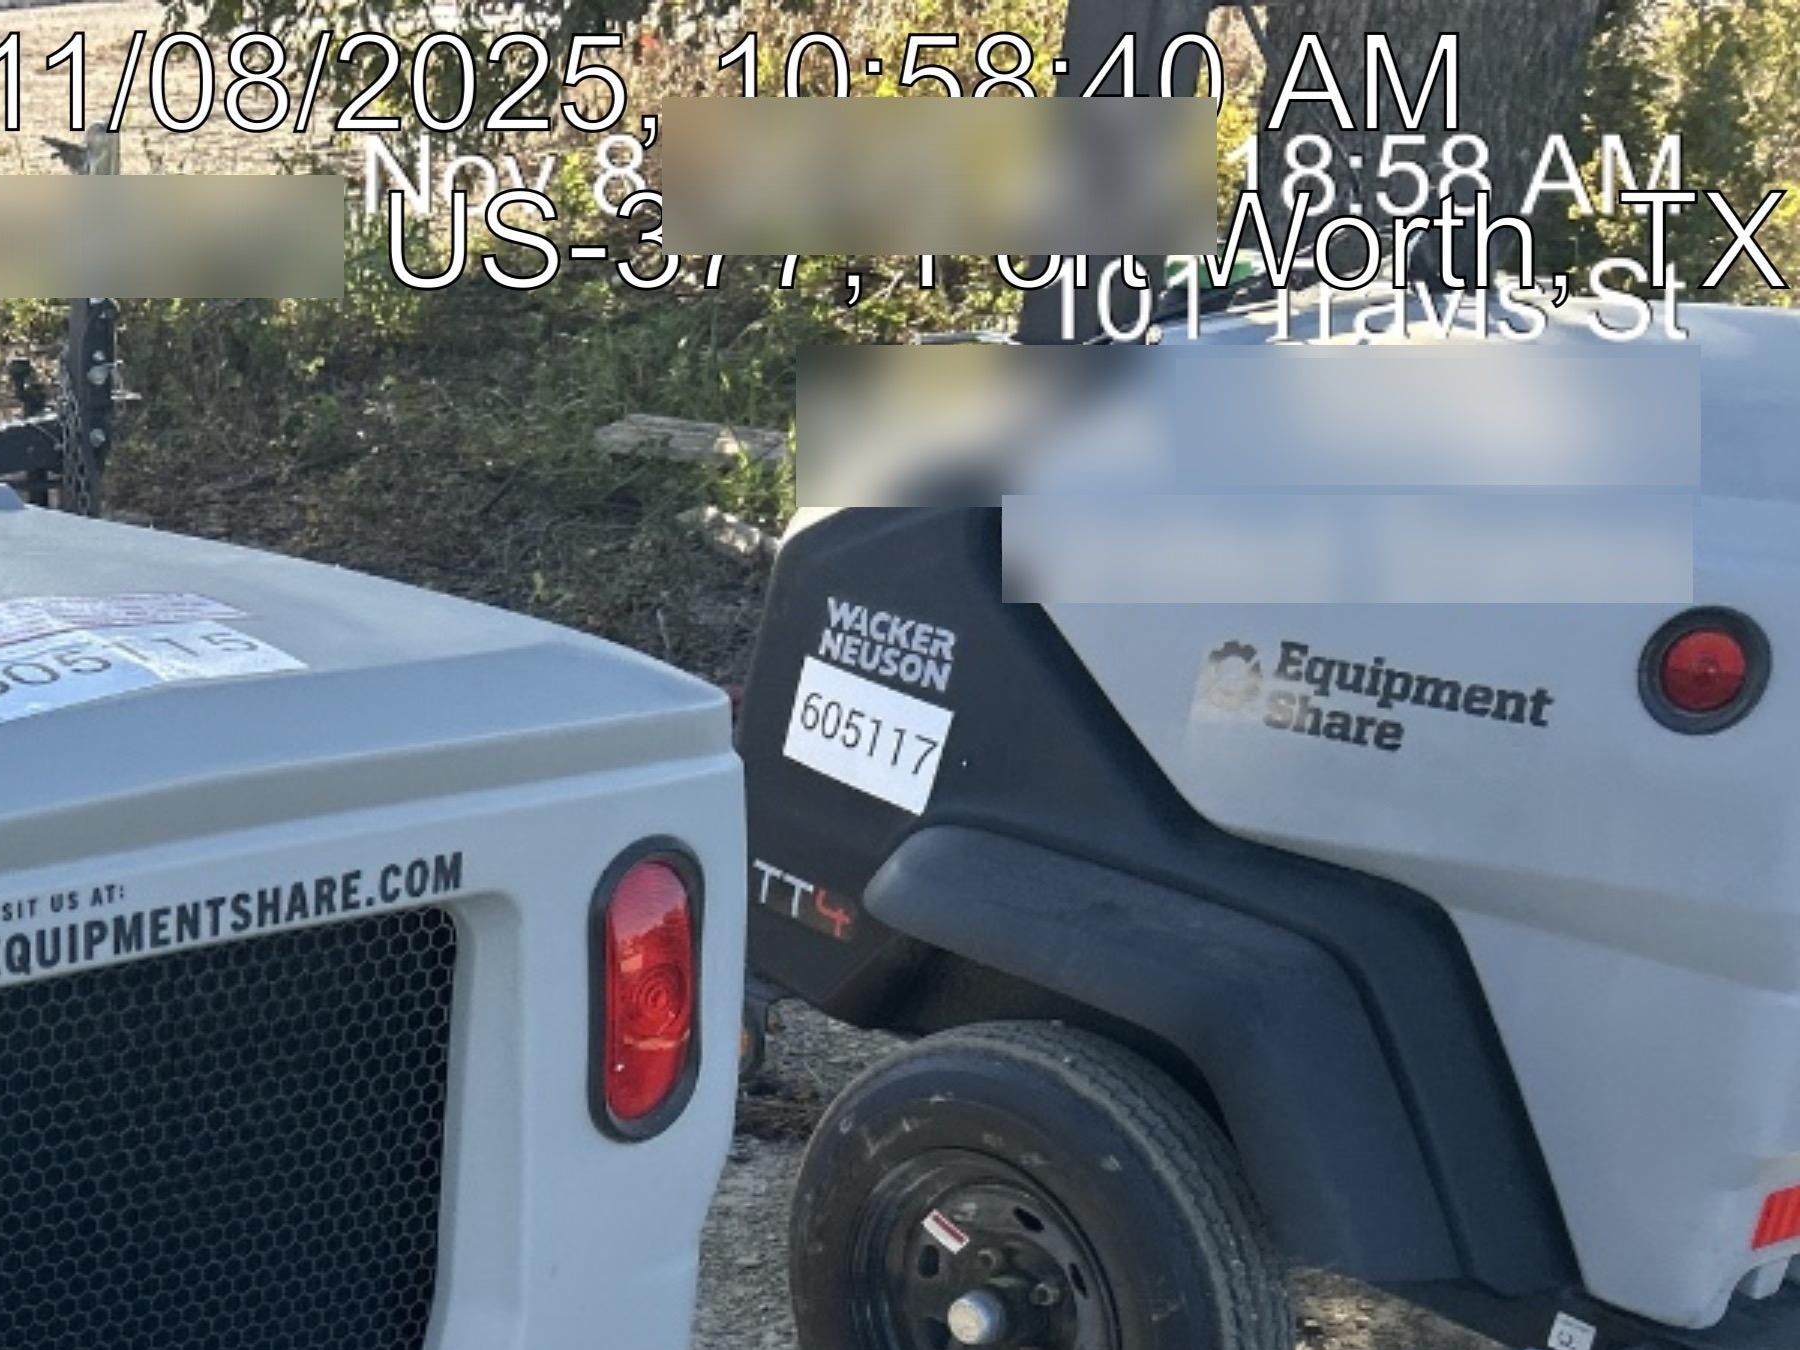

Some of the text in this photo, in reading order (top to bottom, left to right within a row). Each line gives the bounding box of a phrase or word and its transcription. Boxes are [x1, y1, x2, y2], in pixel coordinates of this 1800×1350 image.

[827, 596, 957, 660] WACKER
[818, 629, 952, 693] NEUSON
[1274, 639, 1554, 727] Equipment
[800, 692, 939, 777] 605117
[1263, 689, 1404, 752] Share
[50, 890, 79, 913] US
[90, 883, 125, 907] AT:
[752, 857, 852, 939] TT4
